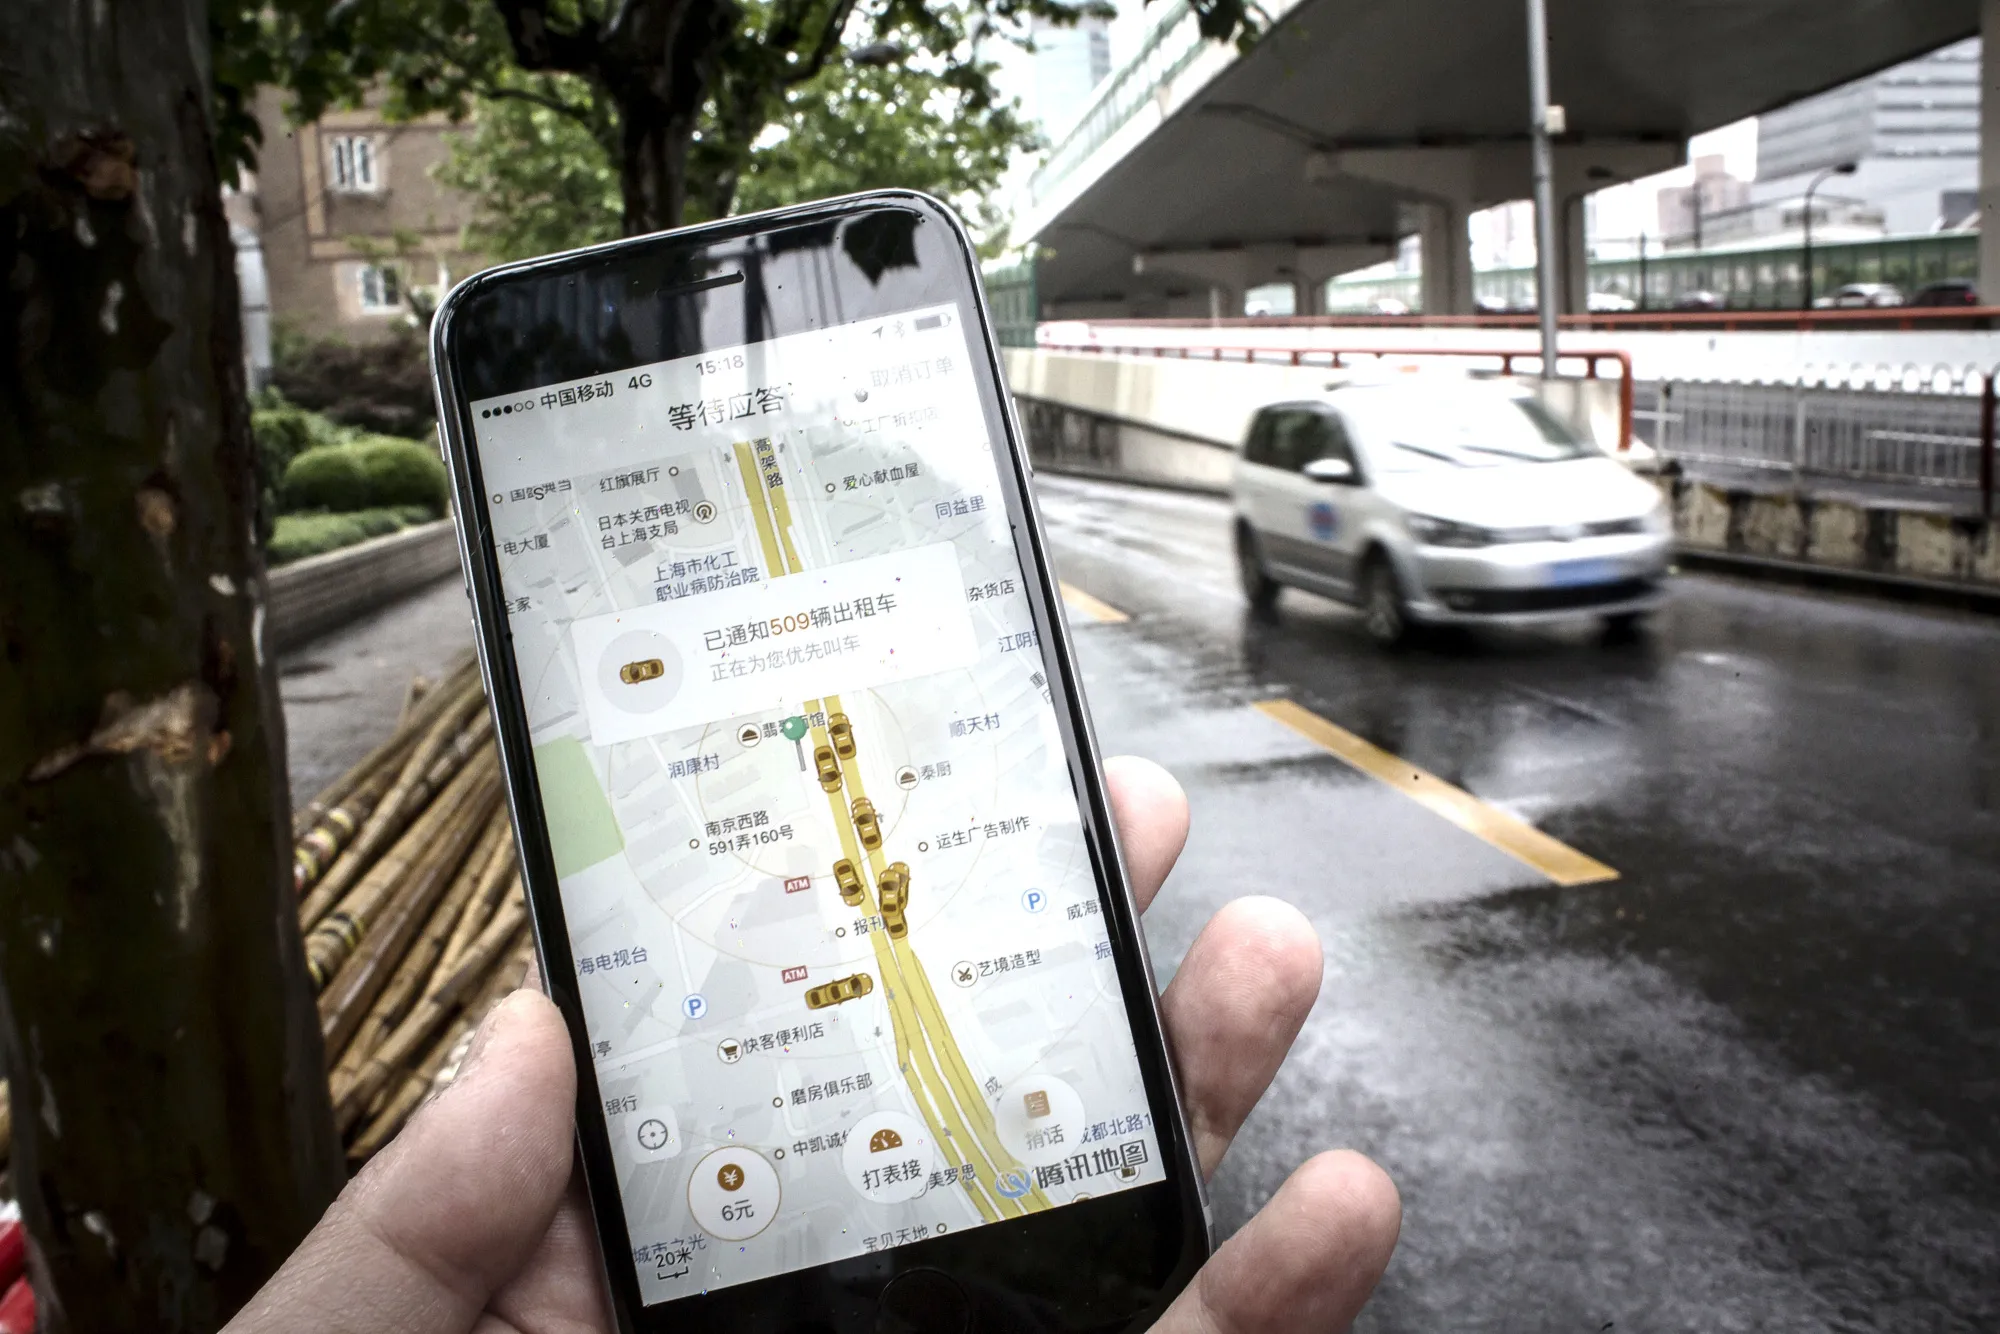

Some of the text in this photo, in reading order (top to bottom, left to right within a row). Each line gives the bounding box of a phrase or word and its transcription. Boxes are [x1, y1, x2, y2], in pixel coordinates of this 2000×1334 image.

[696, 355, 744, 376] 15:18
[540, 380, 614, 410] 中国移动
[628, 374, 653, 391] 4G
[668, 386, 784, 432] 等待应答
[755, 437, 784, 489] 高架路
[843, 463, 920, 492] 爱心献血屋
[600, 467, 660, 493] 红旗展厅
[598, 499, 691, 531] 日本关西电视
[935, 495, 987, 520] 同益里
[495, 534, 550, 555] 电大厦
[601, 521, 679, 550] 台上海支局
[653, 551, 738, 582] 上海市化工
[656, 567, 760, 602] 职业病防治院
[968, 579, 1015, 602] 杂货店
[710, 634, 861, 682] 正在为您优先叫车
[949, 712, 1001, 738] 顺天村
[668, 752, 720, 779] 润康村
[705, 809, 770, 838] 南京西路
[936, 815, 1030, 851] 运生广告制作
[709, 824, 794, 856] 591弄160号
[786, 878, 810, 893] ATM
[1067, 898, 1103, 920] 威海
[782, 967, 806, 983] ATM
[977, 948, 1042, 978] 艺境造型
[743, 1022, 825, 1056] 快客便利店
[605, 1094, 639, 1116] 银行
[862, 1158, 923, 1190] 打表接
[1035, 1139, 1149, 1189] 腾讯地图
[721, 1199, 754, 1221] 6元
[655, 1247, 693, 1268] 20米
